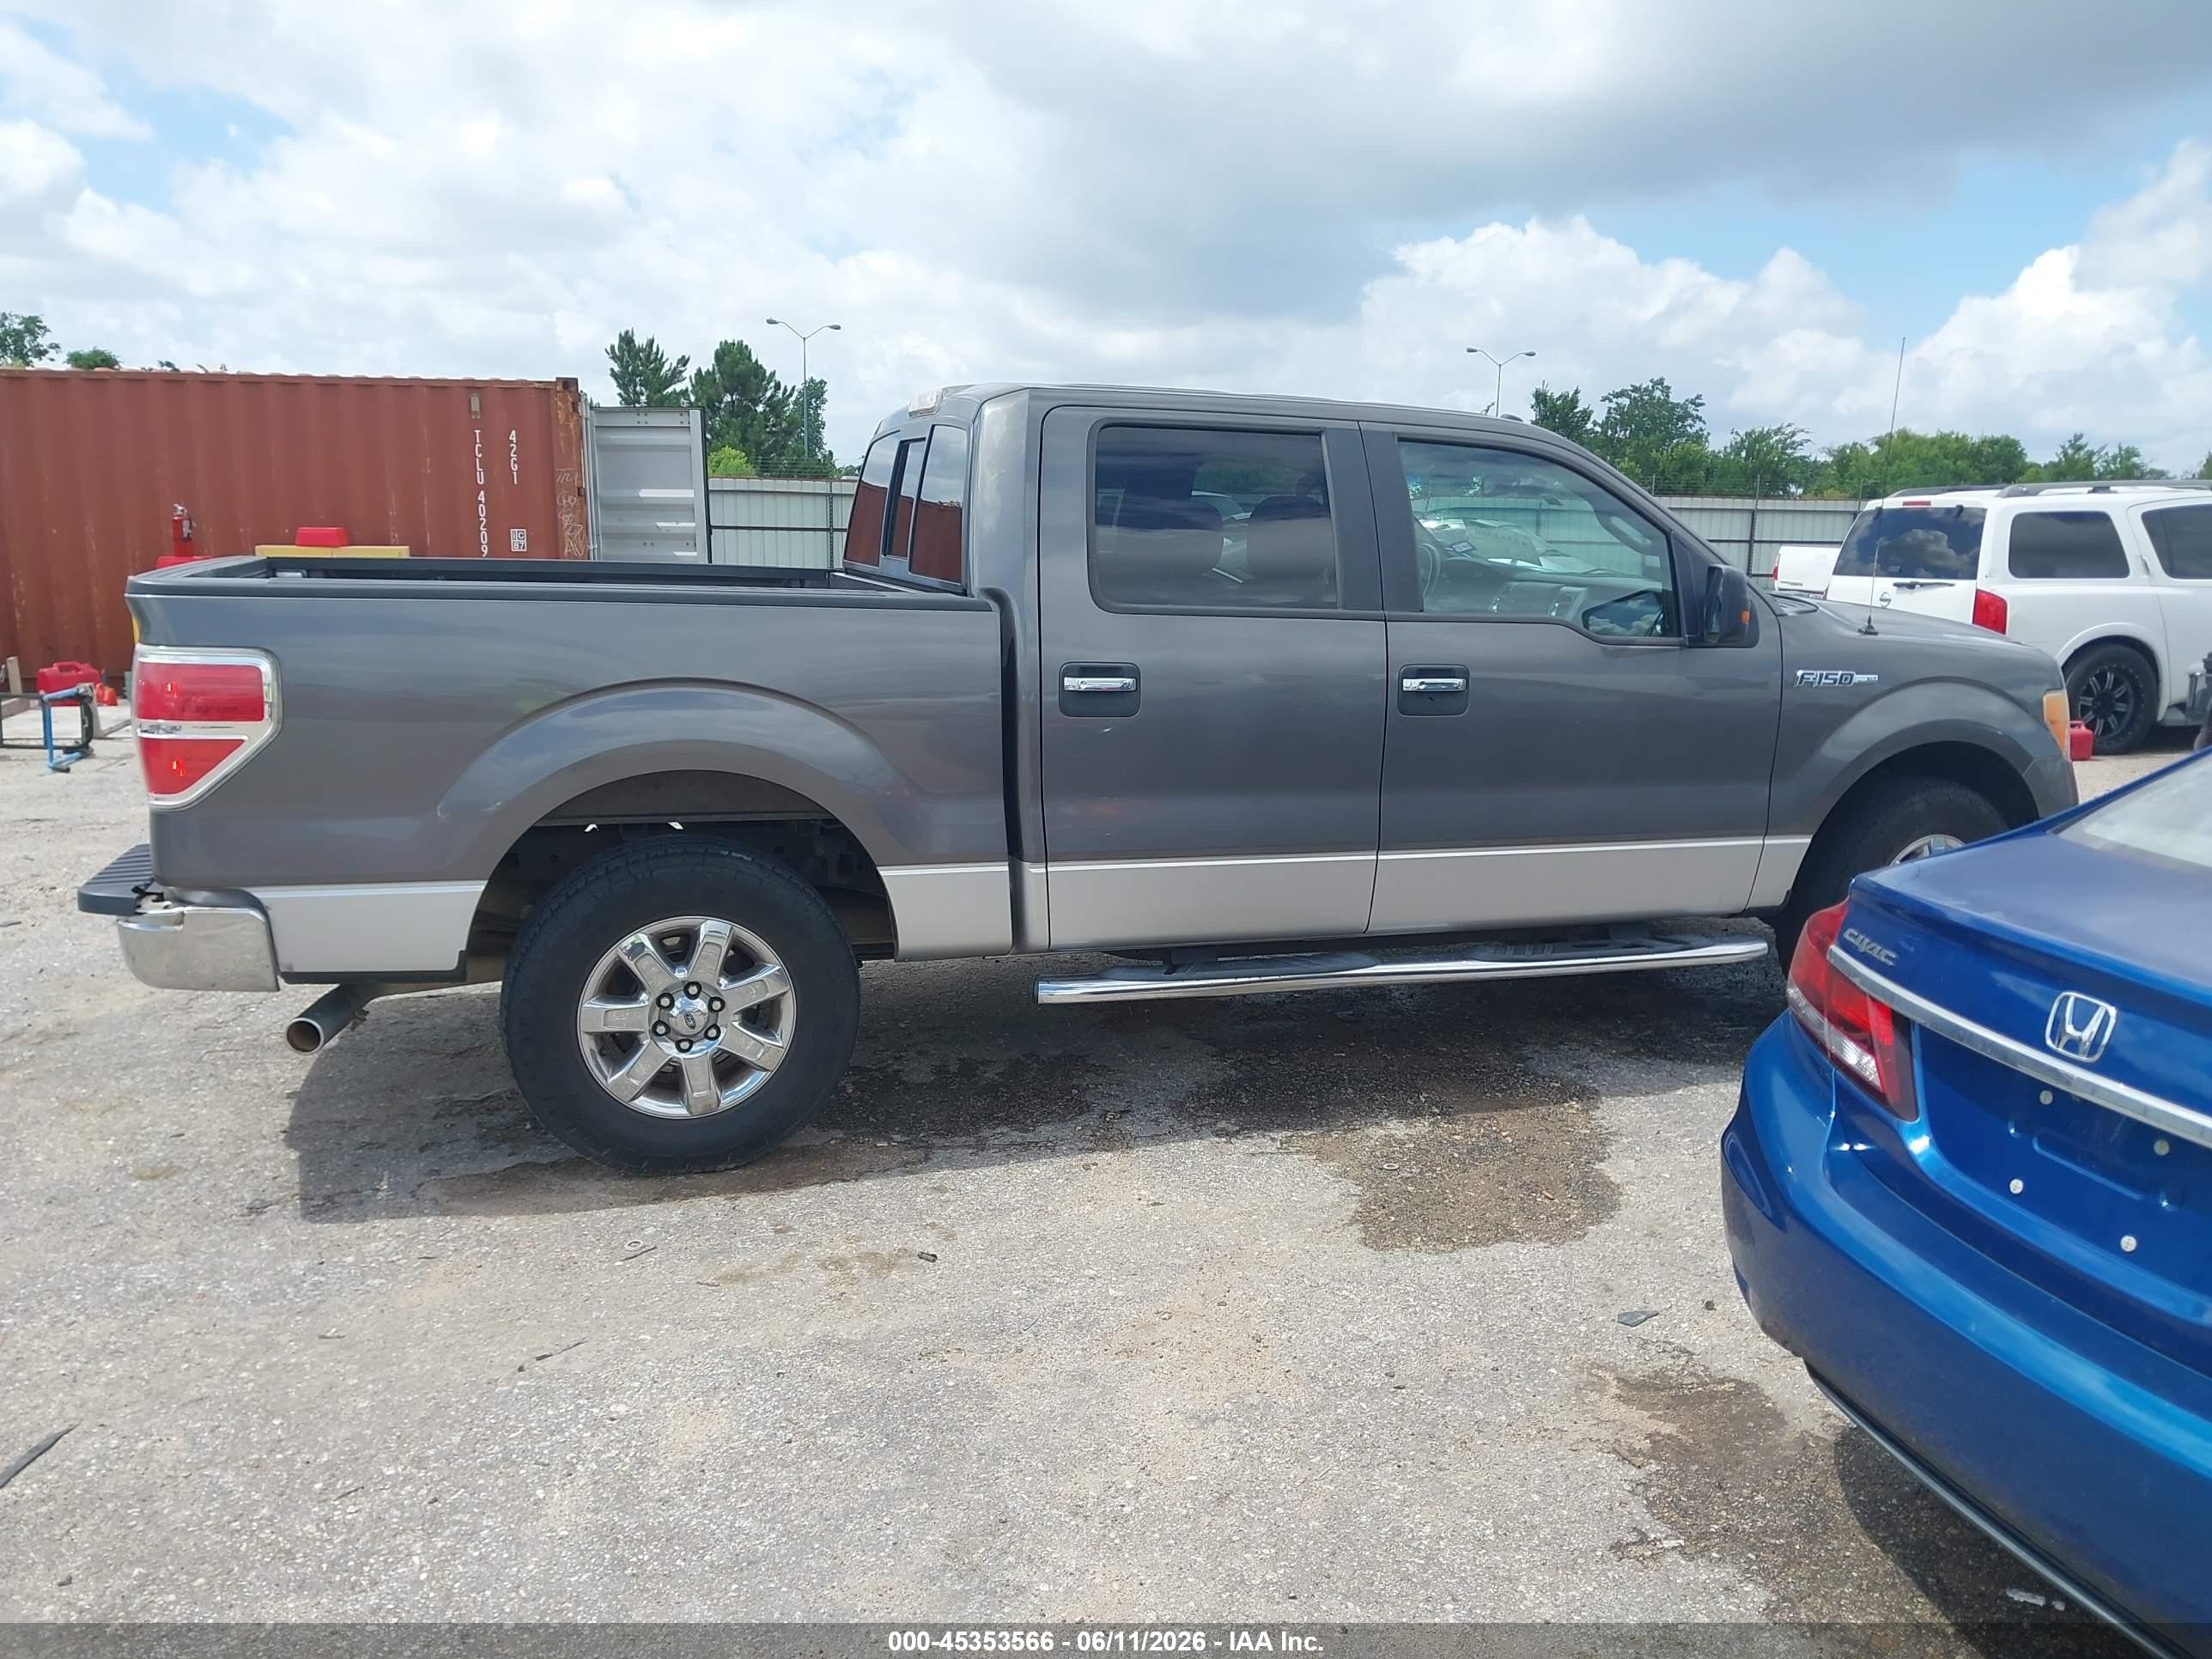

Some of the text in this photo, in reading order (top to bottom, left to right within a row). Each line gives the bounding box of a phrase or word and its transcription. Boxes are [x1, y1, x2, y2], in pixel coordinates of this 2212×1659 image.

[508, 429, 519, 485] 42G1
[474, 429, 489, 557] TCLU 40209
[1843, 928, 1897, 966] CIVIC
